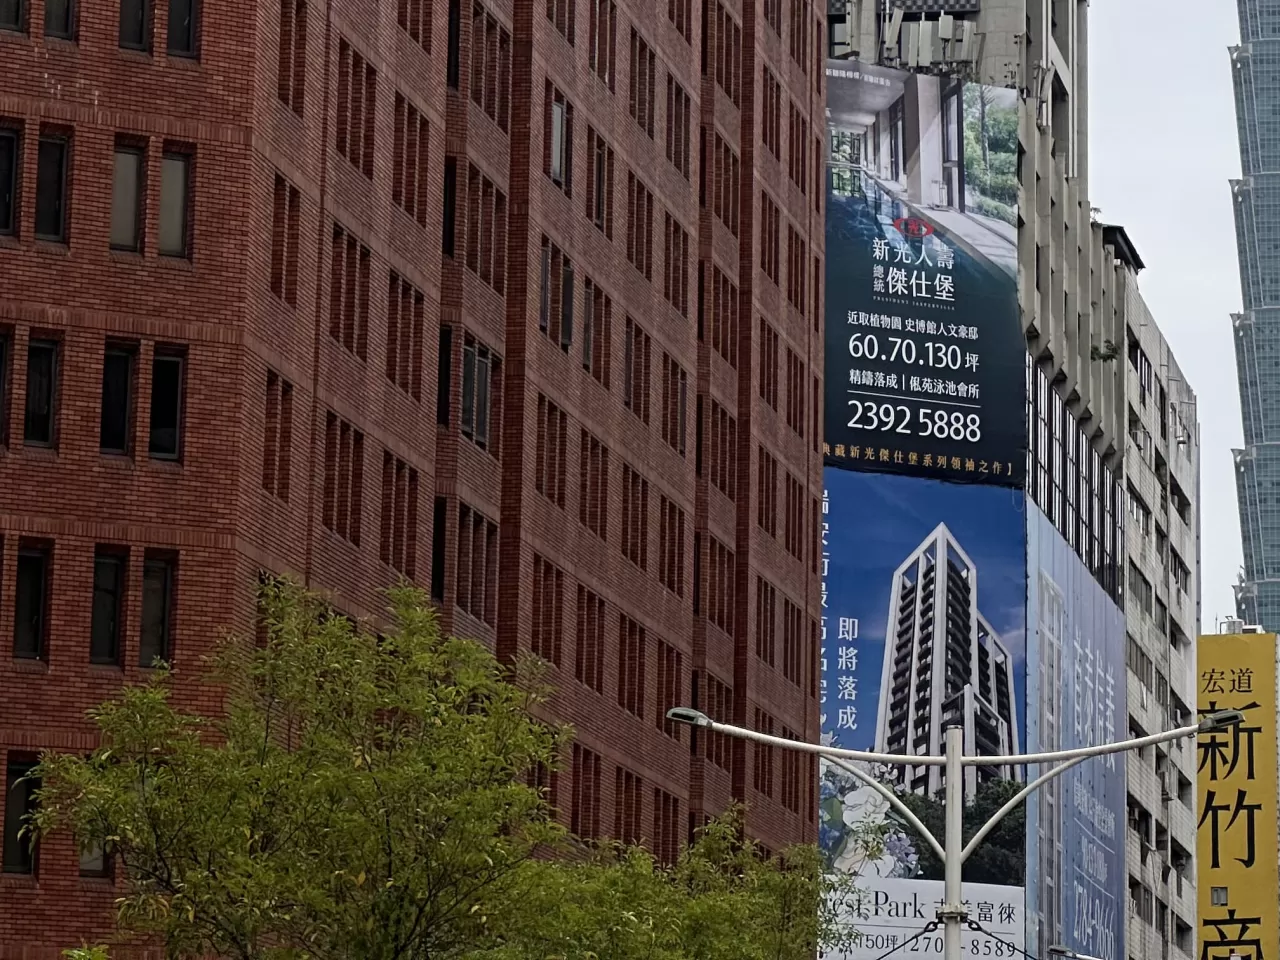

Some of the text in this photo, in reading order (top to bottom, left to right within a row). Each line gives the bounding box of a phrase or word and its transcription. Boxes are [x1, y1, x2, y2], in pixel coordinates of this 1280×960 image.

[872, 236, 955, 270] 新光人壽
[886, 266, 956, 302] 傑仕堡
[847, 310, 979, 341] 近取植物園 史博館人文豪邸
[847, 399, 981, 442] 2392 5888
[837, 617, 859, 730] 即將落成
[1201, 668, 1254, 694] 宏道
[873, 890, 926, 919] Park
[910, 936, 1016, 958] 270-8589
